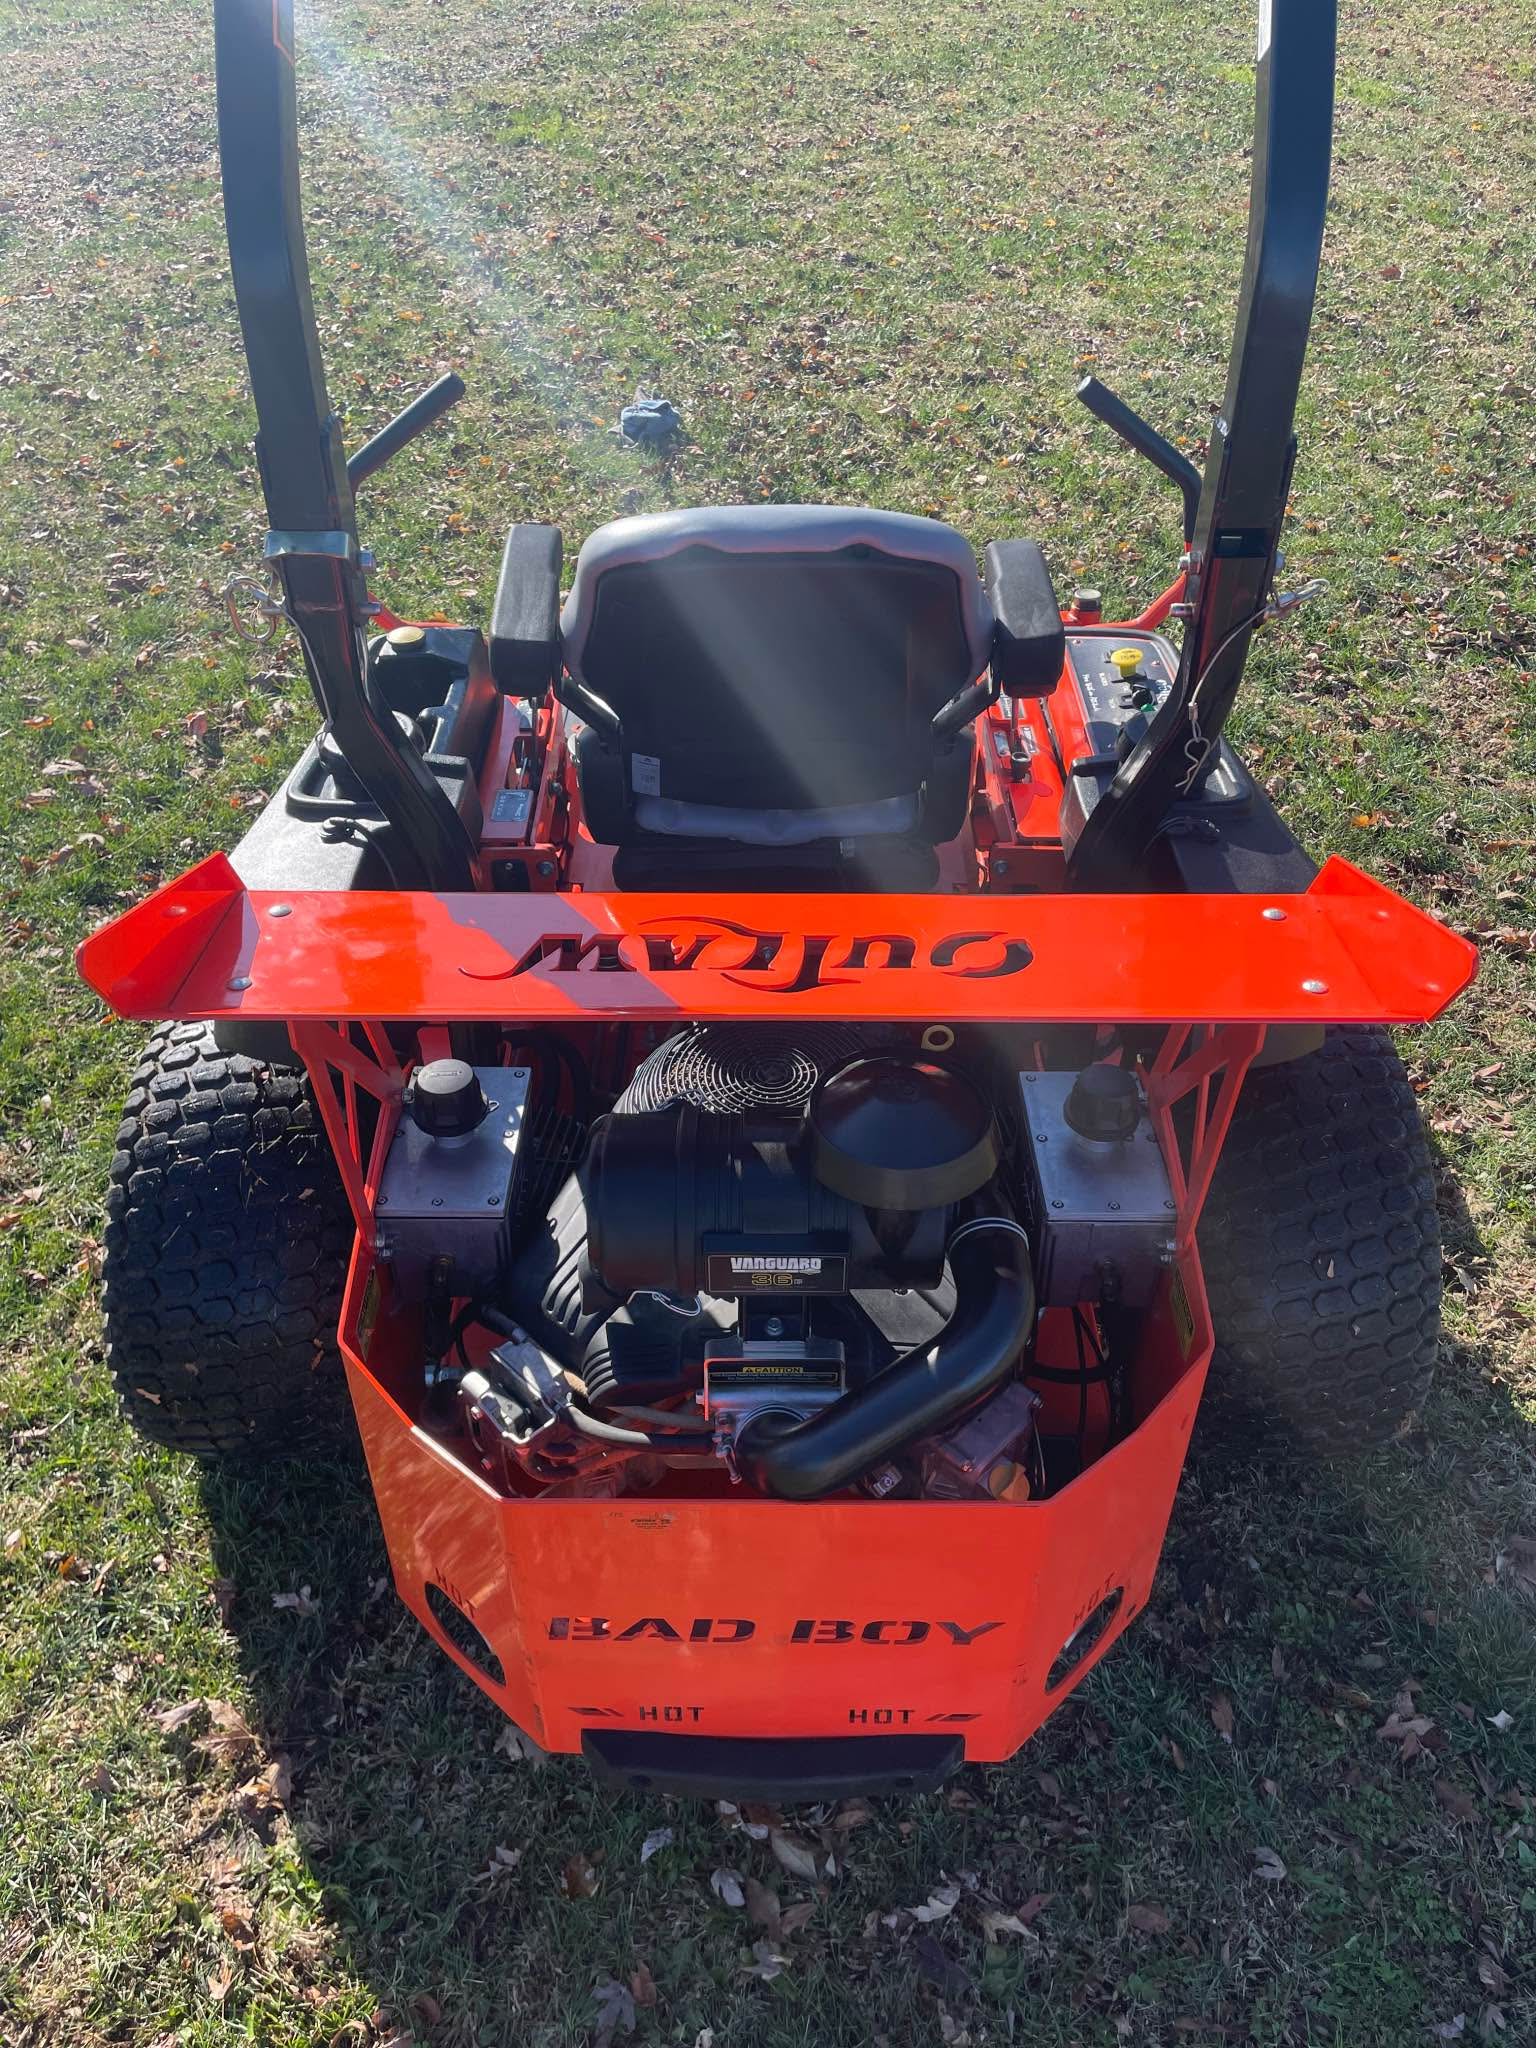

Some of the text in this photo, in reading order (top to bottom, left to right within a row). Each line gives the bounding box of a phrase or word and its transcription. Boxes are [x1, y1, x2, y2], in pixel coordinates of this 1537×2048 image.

[730, 1257, 822, 1270] VANGUARD
[751, 1273, 793, 1286] 36
[548, 1616, 1006, 1645] BAD BOY
[639, 1706, 705, 1721] HOT
[849, 1709, 915, 1724] HOT
